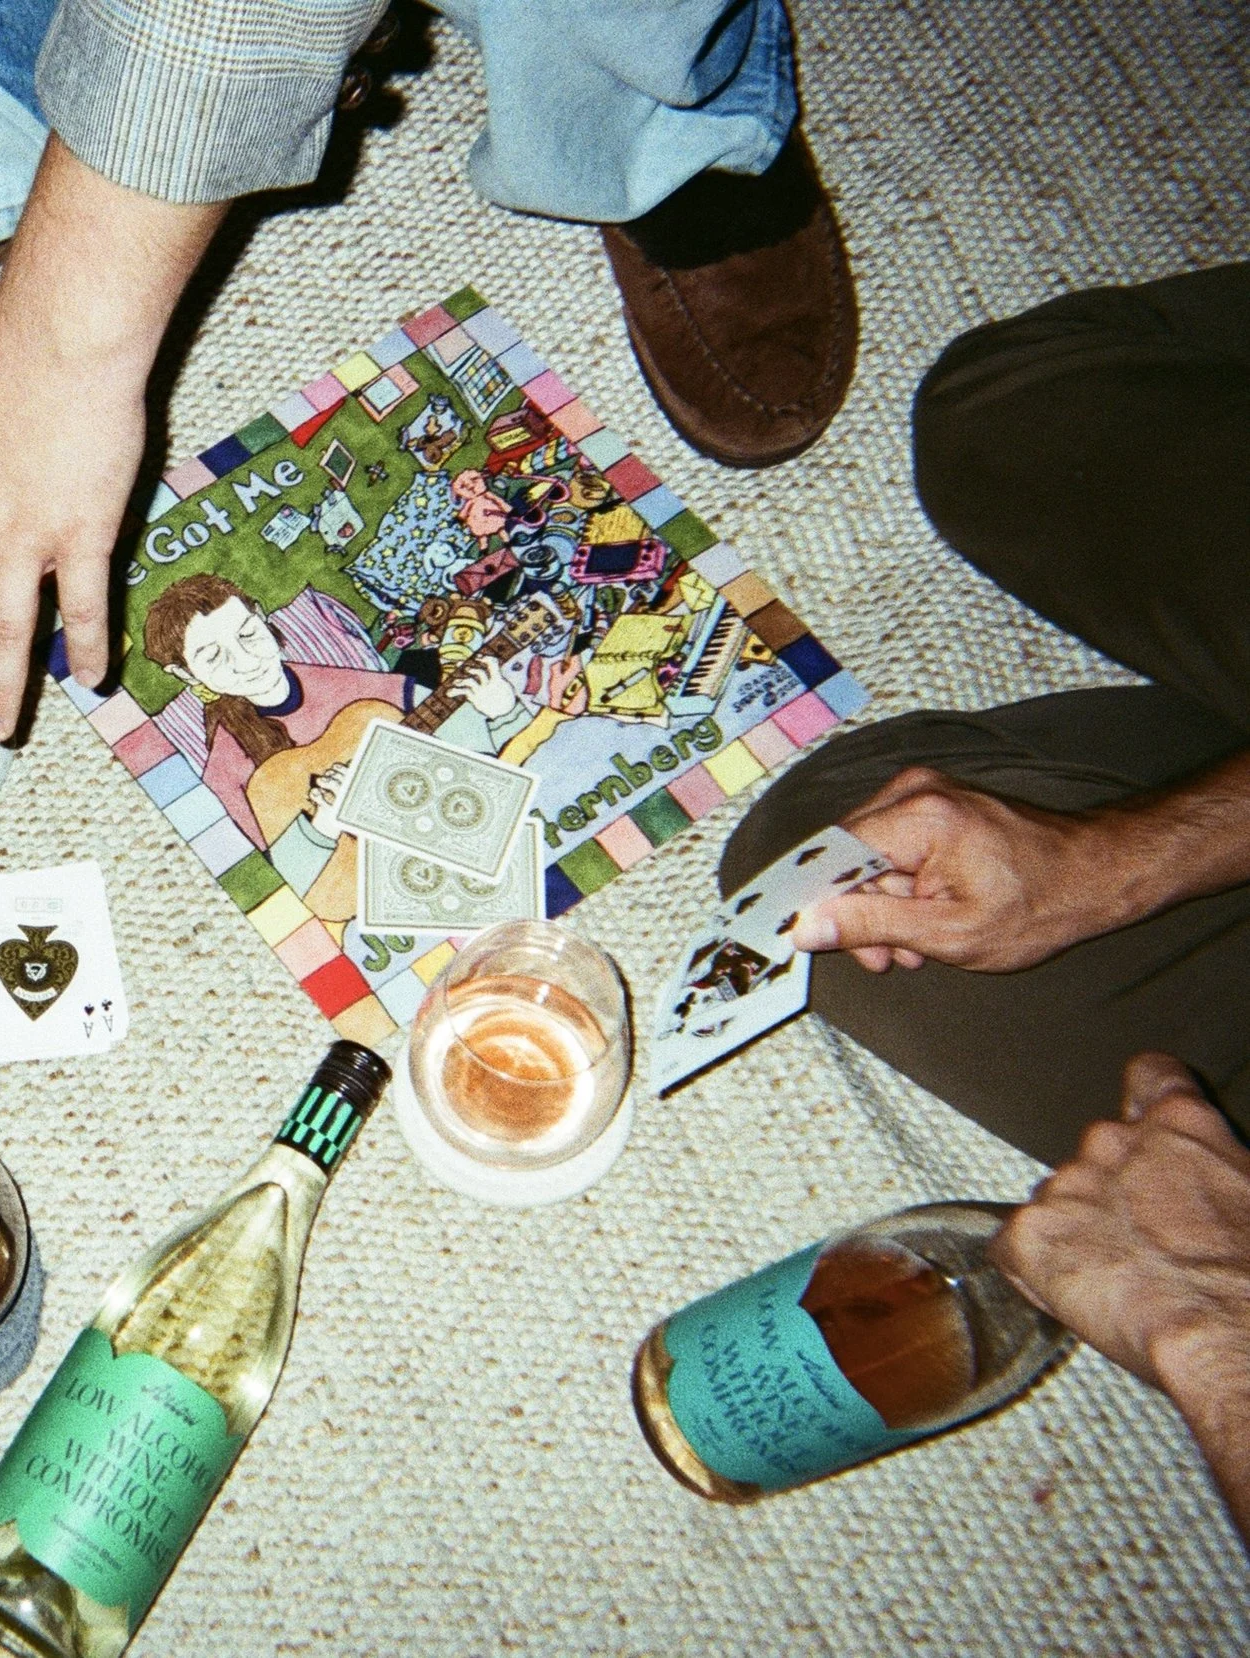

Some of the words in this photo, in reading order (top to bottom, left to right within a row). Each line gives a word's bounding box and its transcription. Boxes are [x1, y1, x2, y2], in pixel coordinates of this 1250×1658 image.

[145, 499, 235, 563] Got
[231, 459, 304, 513] Me
[529, 716, 723, 848] ternberg
[64, 1438, 178, 1534] WITHOUT
[65, 1378, 116, 1416] LOW
[121, 1411, 213, 1490] ALCOHO
[107, 1428, 173, 1492] WINE
